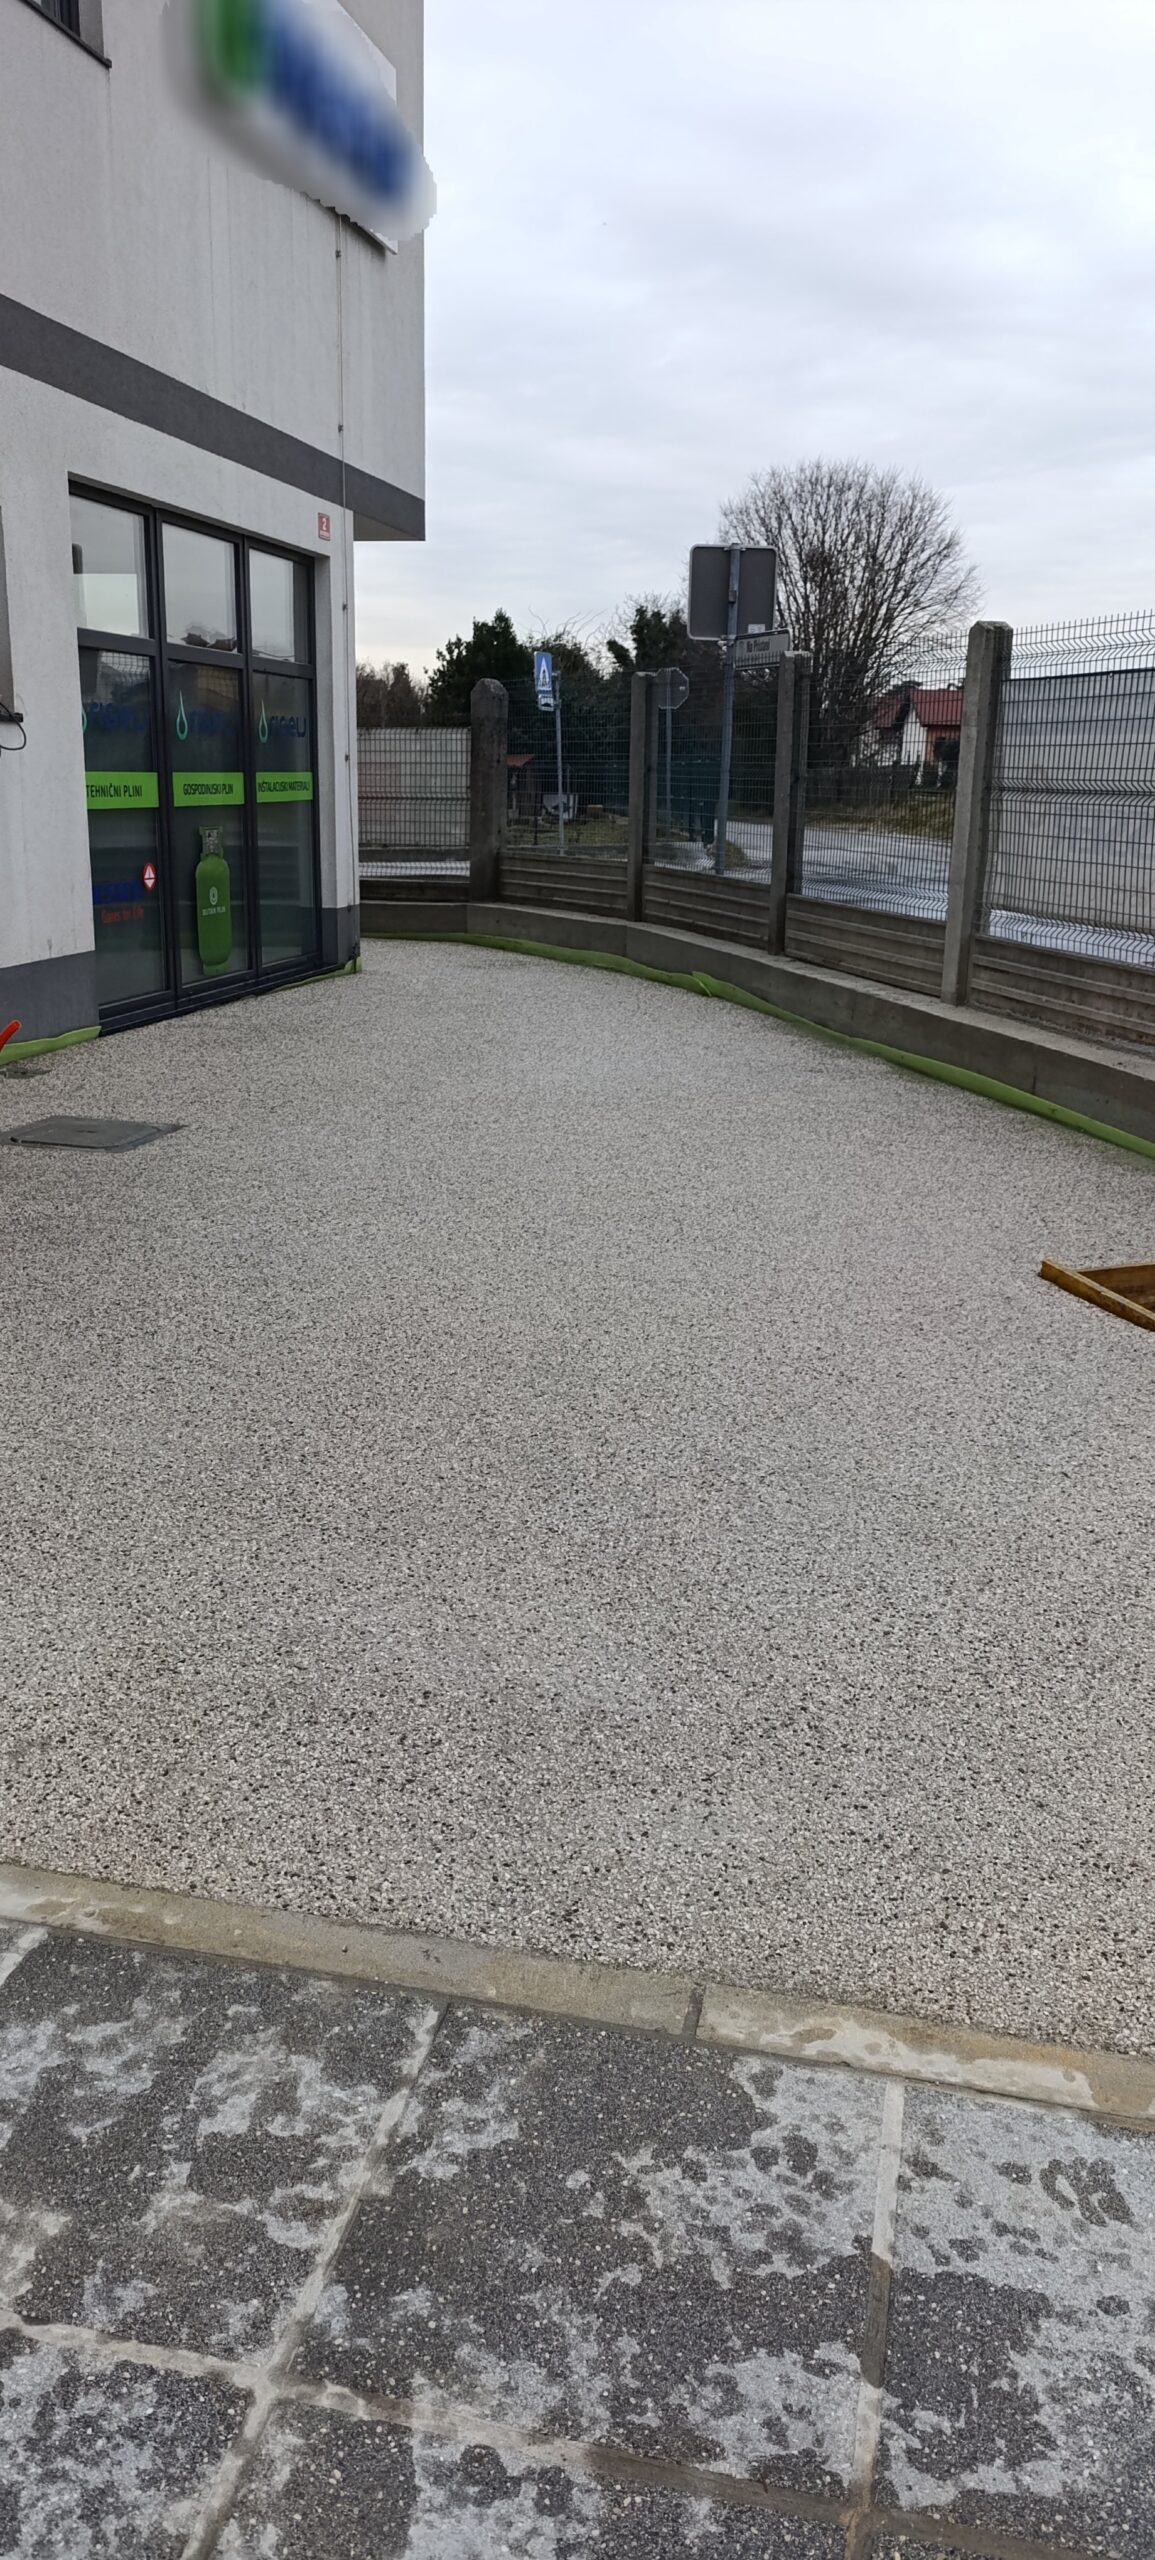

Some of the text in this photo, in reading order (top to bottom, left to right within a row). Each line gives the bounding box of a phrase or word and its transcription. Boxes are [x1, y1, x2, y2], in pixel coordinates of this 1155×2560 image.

[322, 518, 327, 530] 2
[86, 782, 143, 798] TEHNIČNI PLINI
